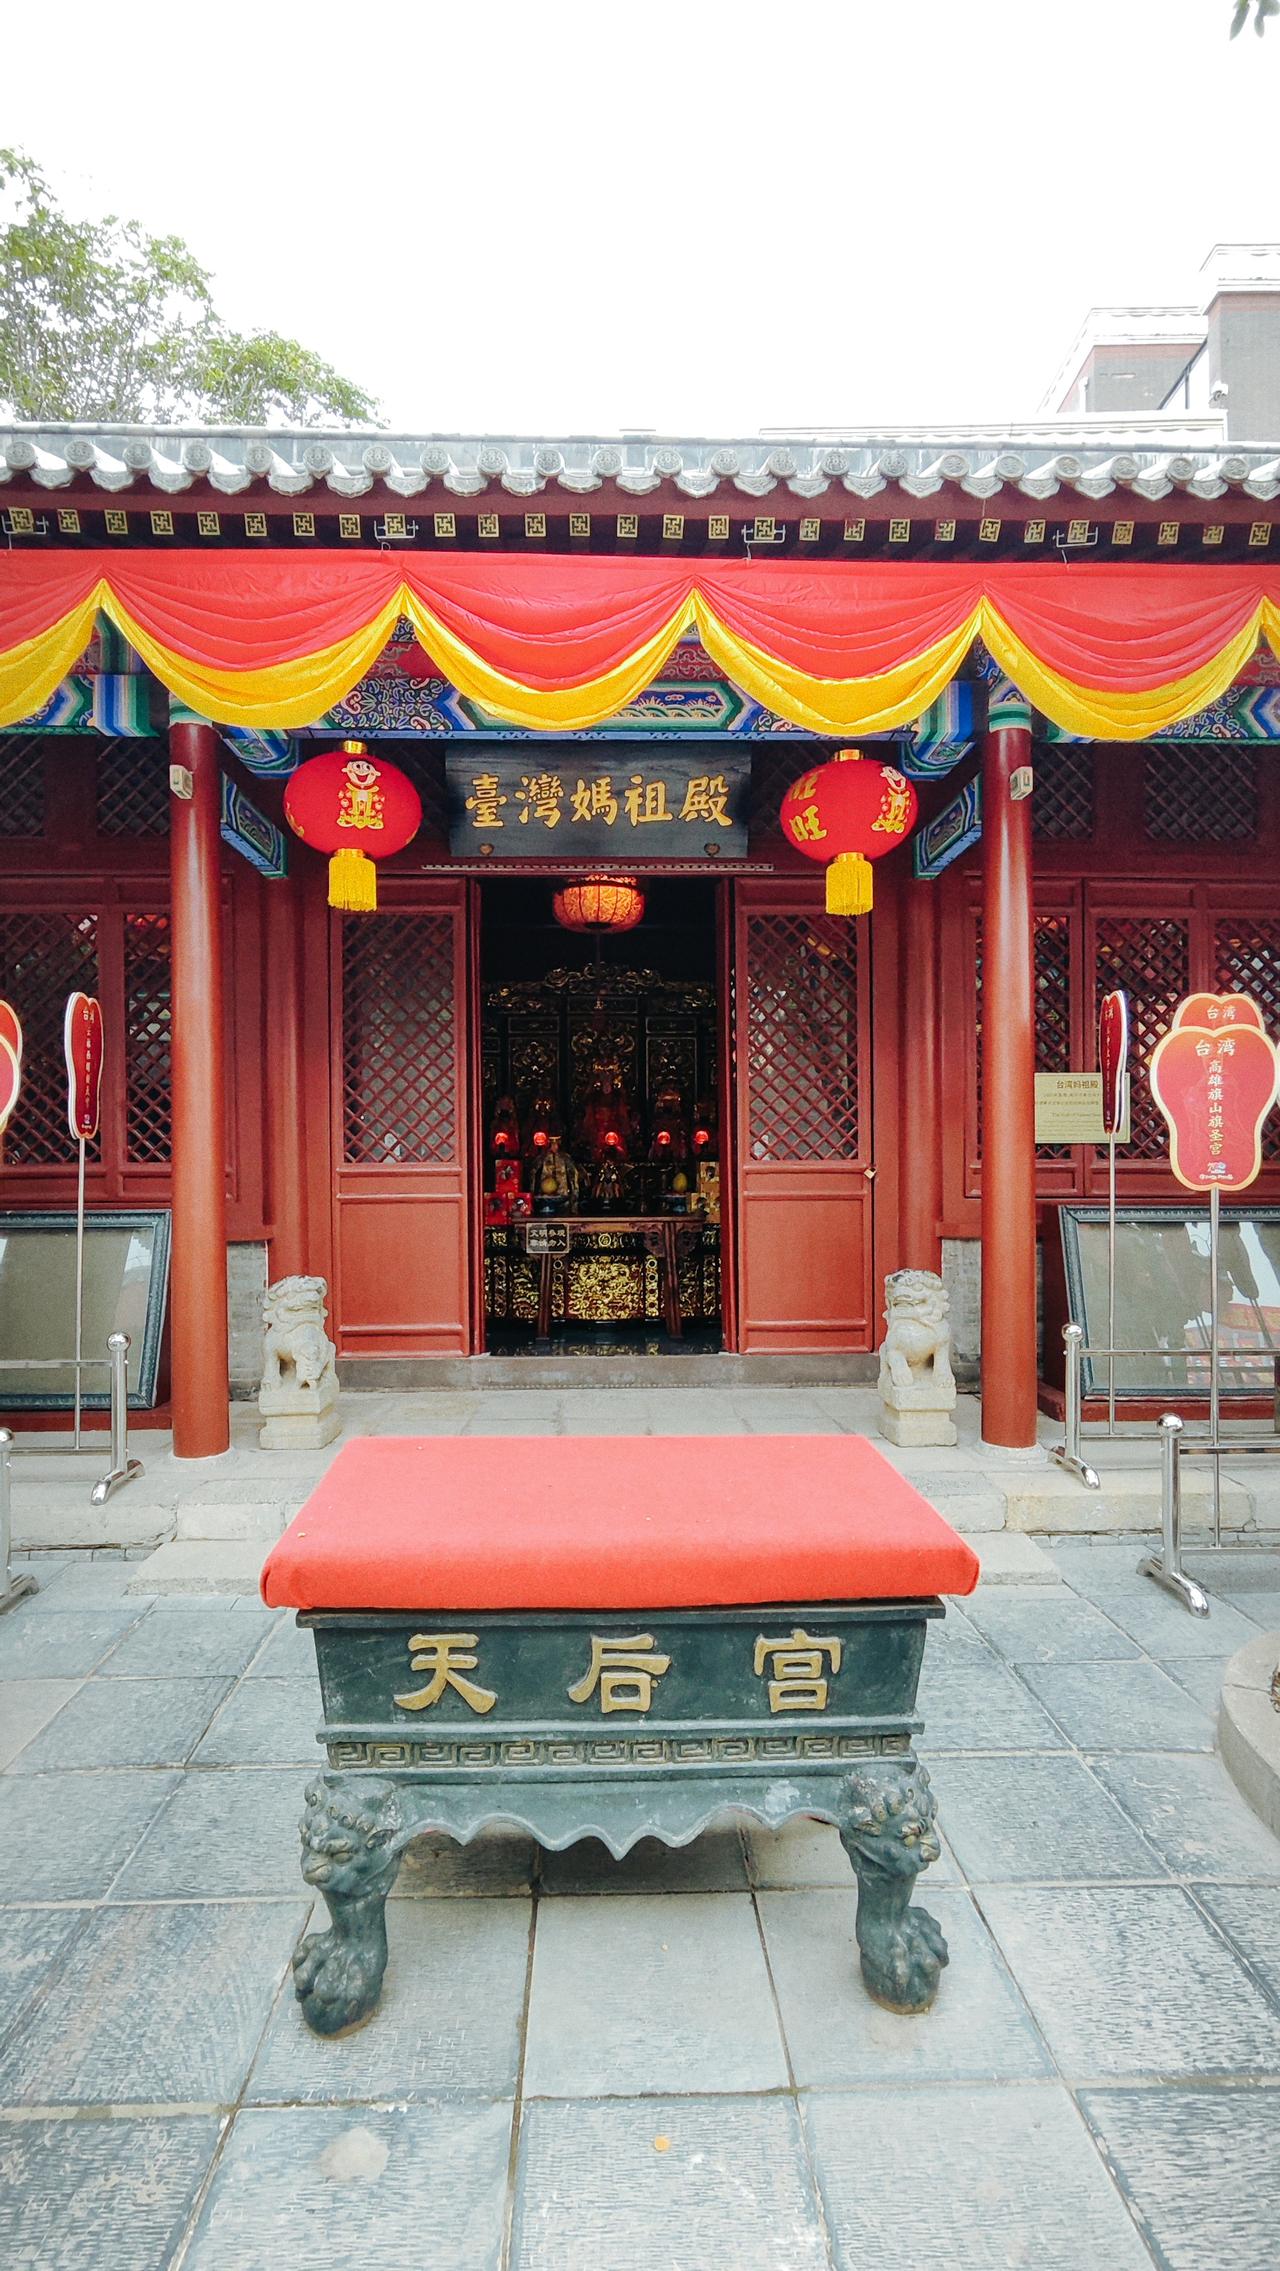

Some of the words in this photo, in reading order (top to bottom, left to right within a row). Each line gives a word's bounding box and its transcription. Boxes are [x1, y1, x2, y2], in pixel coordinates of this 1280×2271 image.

[465, 773, 733, 829] 臺灣媽祖殿
[1206, 1005, 1237, 1020] 台湾
[1195, 1038, 1236, 1057] 台湾
[1056, 1080, 1099, 1089] 台湾妈祖殿
[1207, 1060, 1225, 1156] 高雄旗山旗圣宫
[394, 1629, 842, 1714] 天后宫
